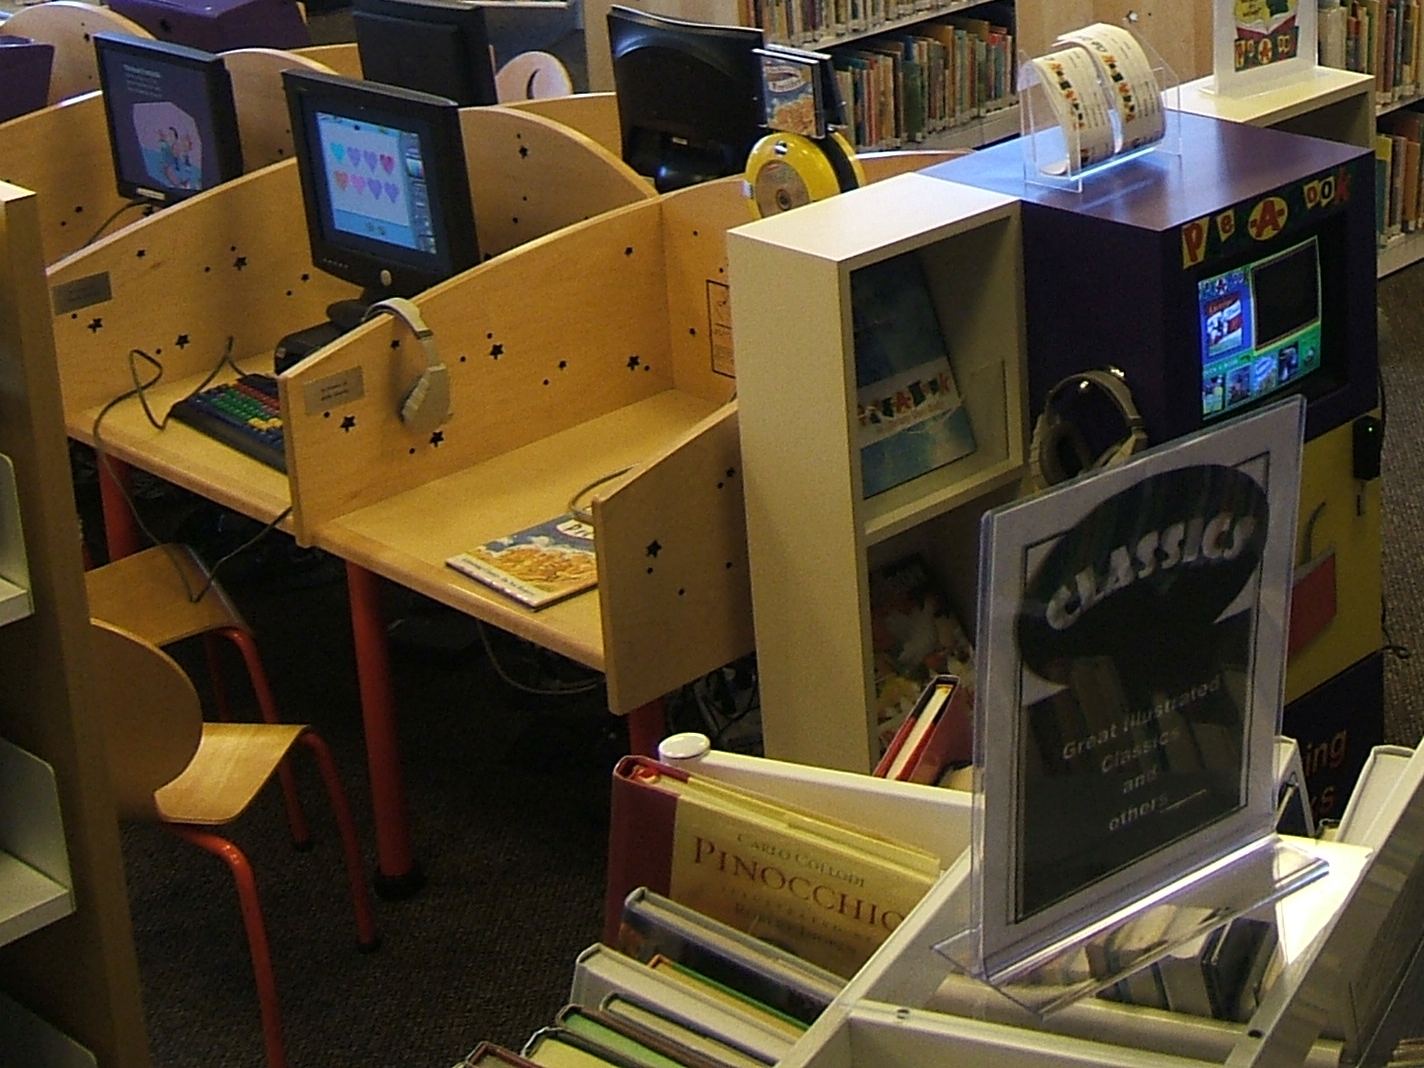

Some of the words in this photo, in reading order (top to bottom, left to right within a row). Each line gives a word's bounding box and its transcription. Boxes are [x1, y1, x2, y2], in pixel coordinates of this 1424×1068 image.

[1046, 511, 1258, 630] CLASSICS
[1062, 722, 1118, 760] Great
[1122, 674, 1222, 733] Illustrated
[1101, 728, 1180, 773] Classics
[1122, 763, 1158, 795] and
[693, 835, 905, 933] PINOCCHIO
